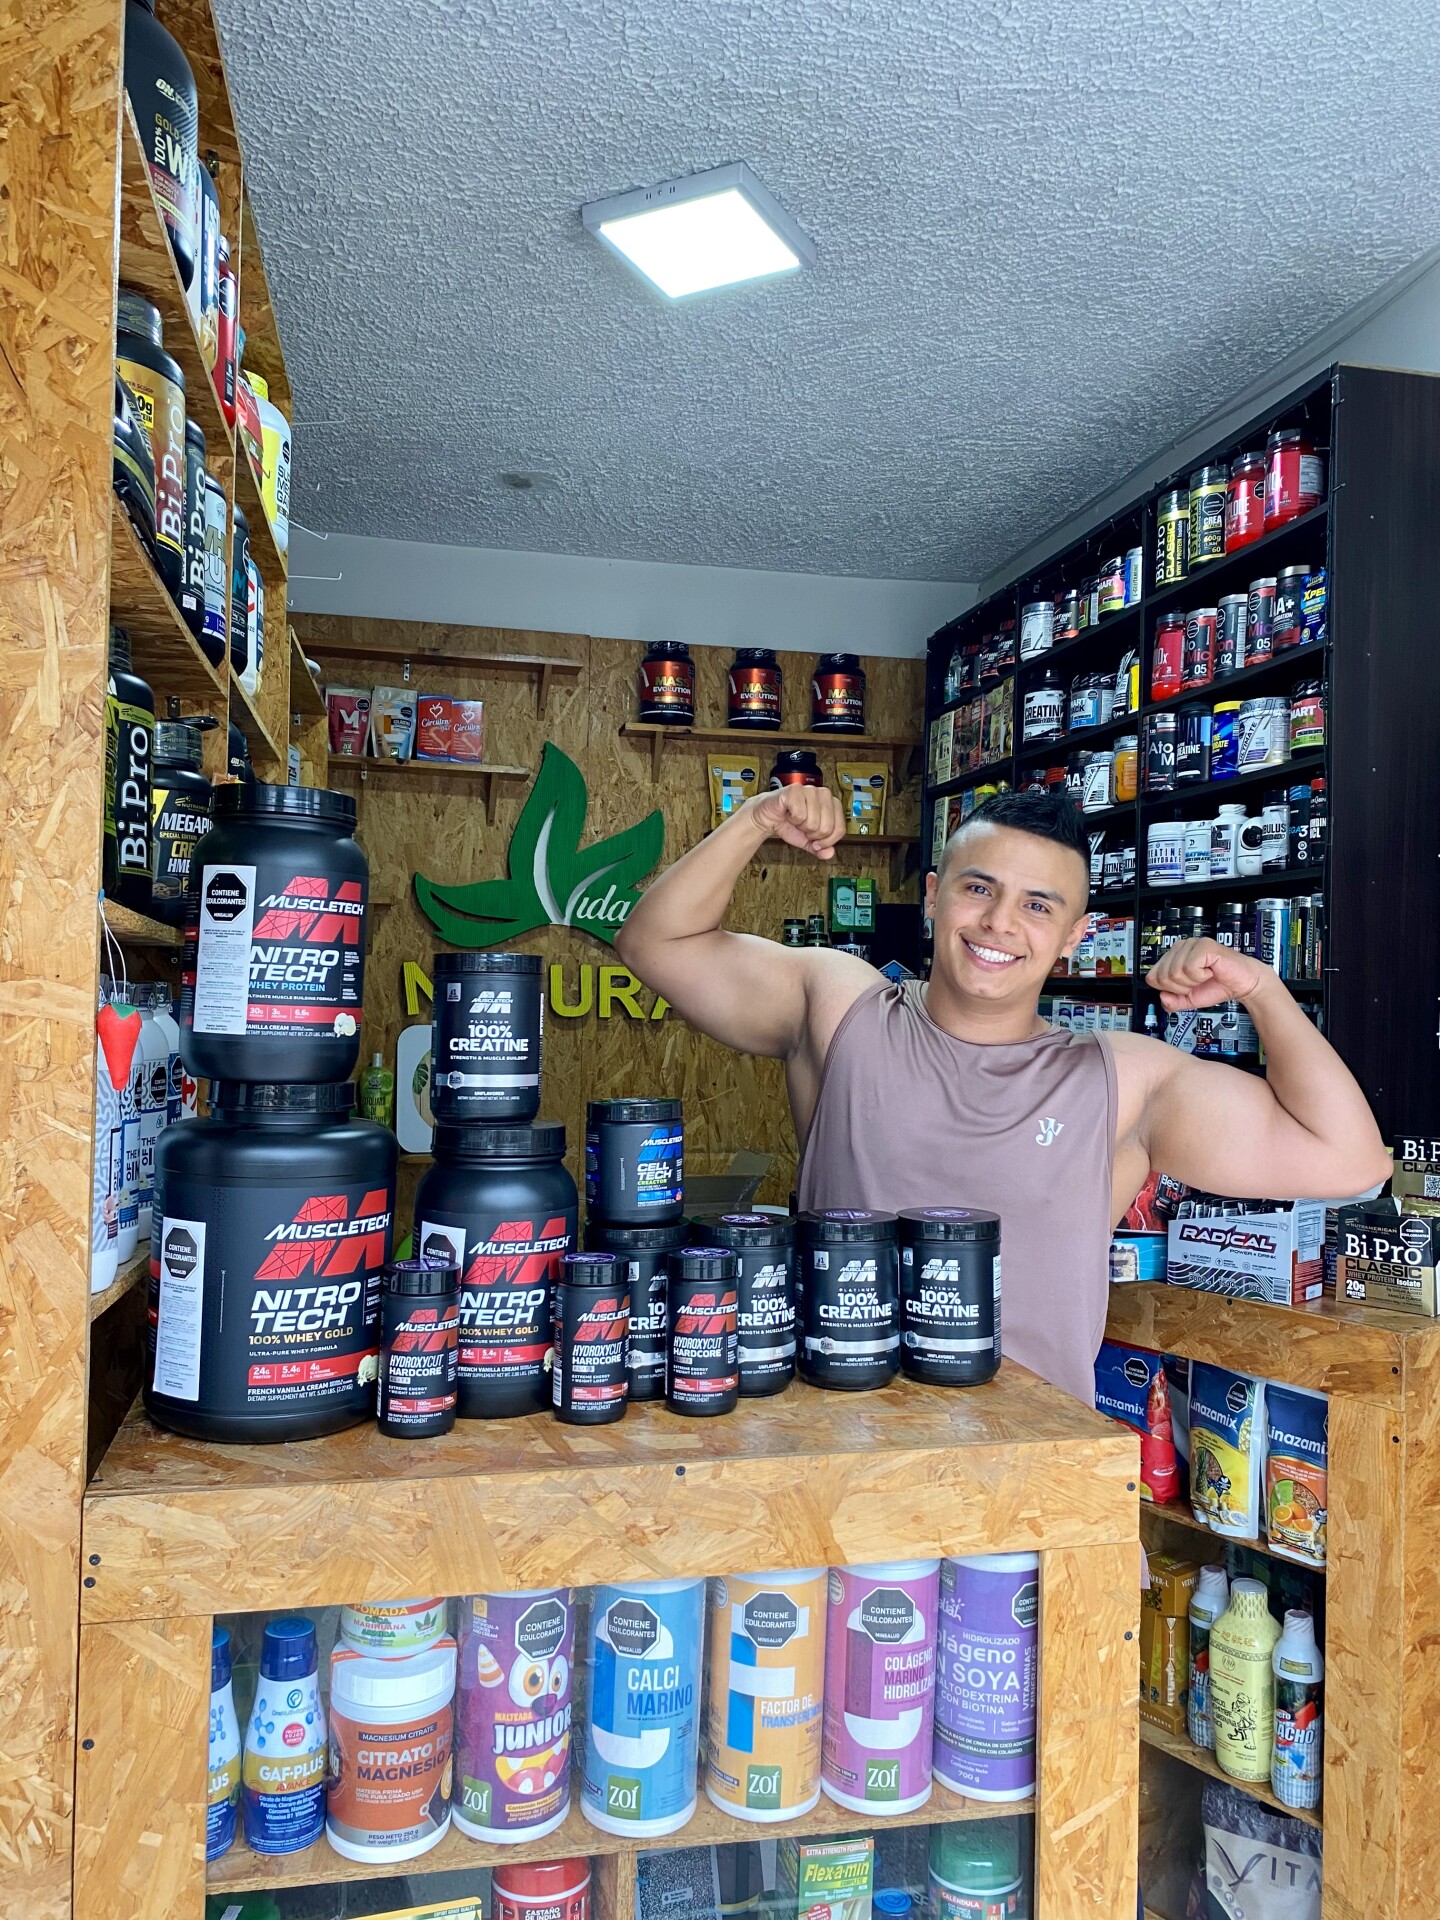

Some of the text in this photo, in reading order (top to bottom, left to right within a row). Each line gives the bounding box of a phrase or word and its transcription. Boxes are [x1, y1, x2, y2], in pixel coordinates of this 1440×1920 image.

[1303, 587, 1327, 602] XPEL
[655, 676, 690, 688] MASS
[742, 683, 776, 694] MASS
[652, 685, 691, 695] EVOLUTION
[740, 691, 778, 701] EVOLUTION
[827, 688, 861, 699] MASS
[825, 698, 863, 706] EVOLUTION
[160, 831, 181, 839] SPECIAL
[211, 888, 240, 898] CONTIENE
[258, 894, 365, 916] MUSCLETECH
[250, 945, 340, 967] NITRO
[249, 963, 328, 983] TECH
[281, 982, 326, 993] PROTEIN
[468, 1025, 513, 1038] 100%
[449, 1038, 529, 1052] CREATINE
[637, 1161, 670, 1172] CELL
[637, 1168, 673, 1181] TECH
[263, 1212, 392, 1241] MUSCLETECH
[468, 1236, 571, 1255] MUSCLETECH
[1182, 1227, 1273, 1251] RADICAL
[168, 1242, 192, 1254] CONTIENE
[1229, 1249, 1253, 1257] POWER
[1345, 1257, 1422, 1279] CLASSIC
[1346, 1279, 1366, 1292] 20g
[1347, 1270, 1422, 1289] WHEY PROTEIN Isolate
[251, 1281, 361, 1312] NITRO
[460, 1288, 546, 1308] NITRO
[837, 1292, 879, 1306] 100%
[919, 1289, 961, 1305] 100%
[1346, 1289, 1366, 1298] PROTEIN
[751, 1296, 787, 1313] 100%
[819, 1302, 893, 1320] CREATINE
[905, 1299, 980, 1318] CREATINE
[250, 1305, 349, 1334] TECH
[459, 1305, 537, 1326] TECH
[484, 1325, 540, 1336] WHEY GOLD
[820, 1321, 847, 1329] STRENGTH
[249, 1326, 353, 1345] 100% WHEY GOLD
[572, 1341, 623, 1356] HYDROXYCUT
[673, 1336, 724, 1350] HYDROXYCUT
[249, 1344, 338, 1357] ULTRA-PURE FORMULA
[673, 1347, 722, 1357] HARDCORE
[389, 1353, 444, 1368] HYDROXYCUT
[572, 1355, 622, 1365] HARDCORE
[389, 1366, 443, 1377] HARDCORE
[247, 1381, 329, 1395] FRENCH VANILLA CREAM
[267, 1392, 298, 1401] SUPPLEMENT
[752, 1610, 790, 1619] CONTIENE
[870, 1606, 907, 1616] CONTIENE
[353, 1618, 407, 1631] MARIHUANA
[525, 1616, 561, 1632] CONTIENE
[612, 1616, 651, 1629] CONTIENE
[744, 1618, 797, 1630] EDULCORANTES
[862, 1614, 913, 1626] EDULCORANTES
[519, 1624, 564, 1642] EDULCORANTES
[608, 1624, 656, 1638] EDULCORANTES
[874, 1632, 901, 1640] MINSALUD
[757, 1636, 783, 1644] MINSALUD
[962, 1631, 1020, 1646] HIDROLIZADO
[618, 1645, 643, 1655] MINSALUD
[884, 1646, 933, 1671] COLÁGENO
[627, 1665, 680, 1692] CALCI
[884, 1665, 924, 1686] MARINO
[952, 1662, 1020, 1691] SOYA
[1023, 1646, 1031, 1712] VITAMINAS
[626, 1684, 694, 1716] MARINO
[761, 1693, 813, 1715] FACTOR DE
[941, 1689, 959, 1706] CON
[494, 1711, 532, 1722] MALTEADA
[362, 1724, 435, 1742] MAGNESIUM CITRATE
[492, 1702, 573, 1755] JUNIOR
[357, 1742, 433, 1766] CITRATO
[958, 1742, 986, 1754] MINERALES
[357, 1749, 446, 1781] MAGNESIO
[958, 1769, 974, 1781] 700
[806, 1848, 822, 1856] EXTRA
[822, 1845, 847, 1855] STRENGTH
[525, 1906, 560, 1917] CASTAÑO
